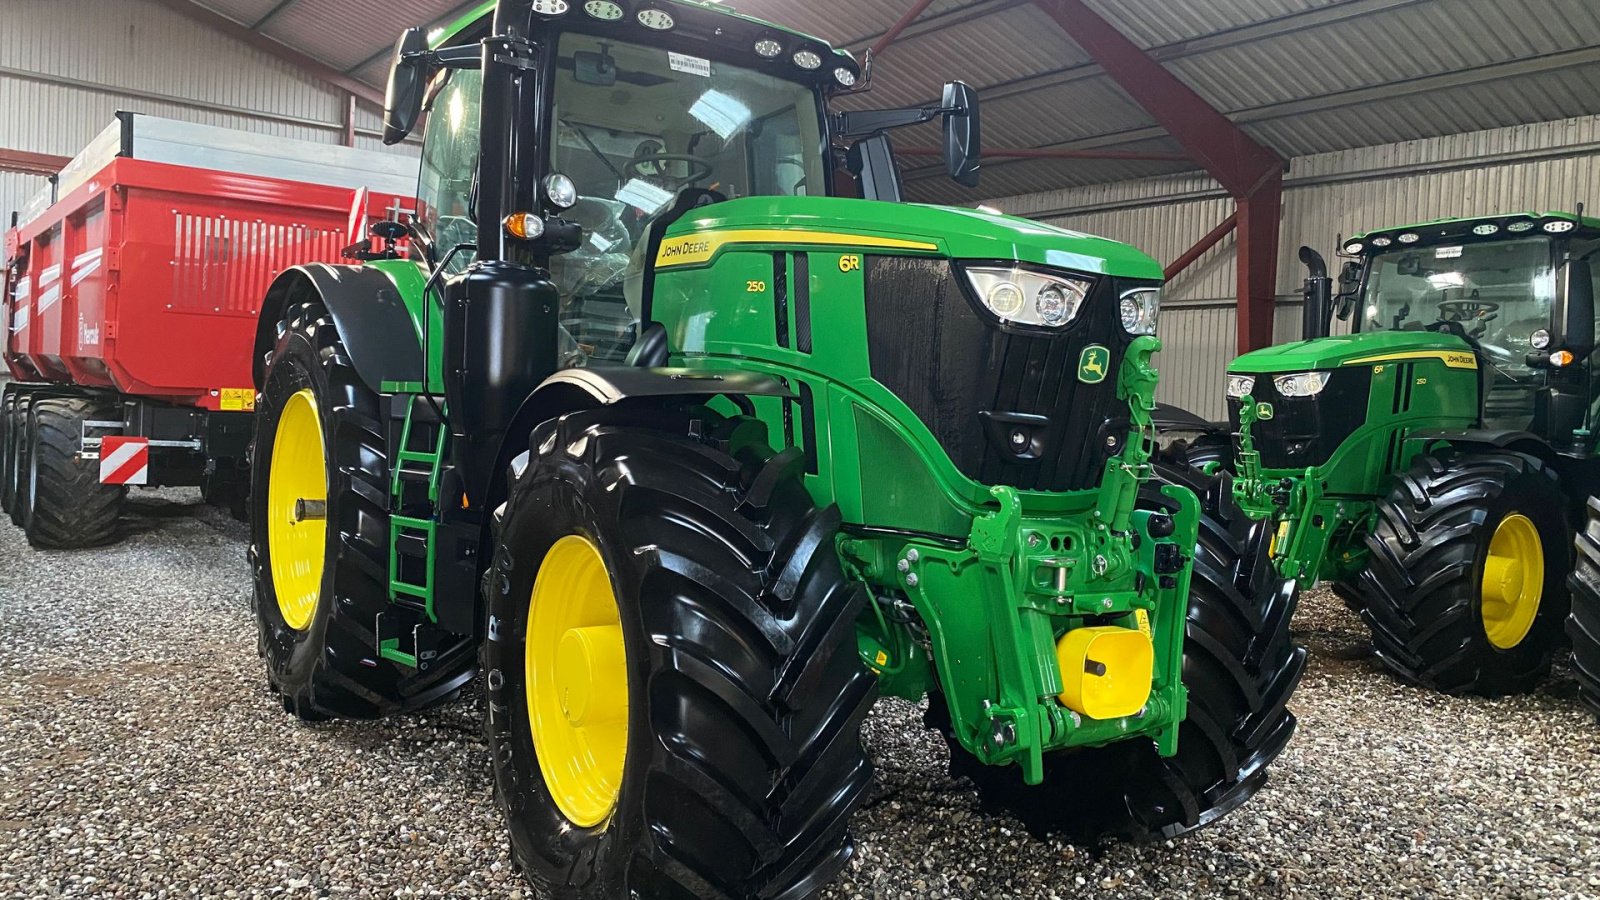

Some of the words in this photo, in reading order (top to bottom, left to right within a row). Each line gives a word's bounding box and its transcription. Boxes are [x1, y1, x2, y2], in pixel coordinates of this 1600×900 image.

[662, 244, 683, 258] JOHN
[682, 241, 710, 255] DEERE
[839, 255, 859, 272] 6R
[746, 280, 766, 293] 250
[1447, 355, 1460, 363] JOHN
[1459, 356, 1474, 365] DEERE
[1374, 365, 1384, 374] 6R
